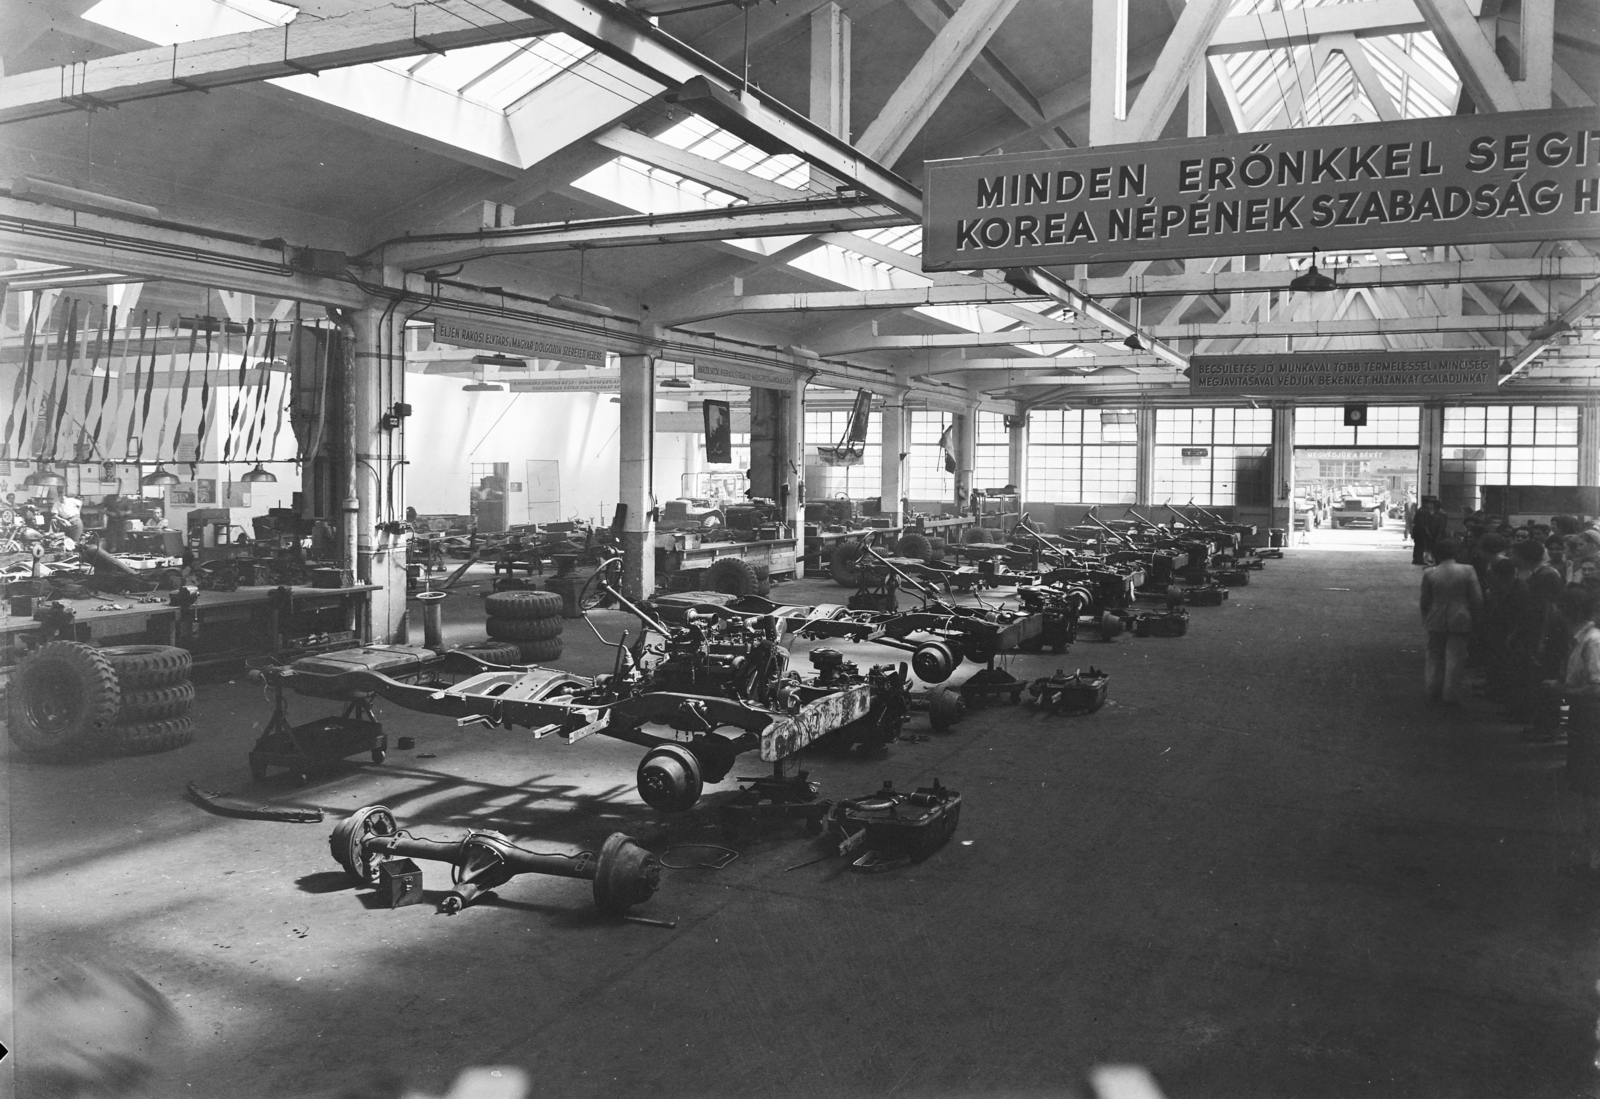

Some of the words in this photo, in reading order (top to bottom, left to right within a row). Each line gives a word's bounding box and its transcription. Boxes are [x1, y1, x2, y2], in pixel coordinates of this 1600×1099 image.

[977, 163, 1147, 209] MINDEN
[1179, 141, 1443, 194] ERŐNKKEL
[956, 211, 1098, 251] KOREA
[1108, 193, 1305, 241] NÉPÉNEK
[1310, 172, 1563, 228] SZABADSÁG
[440, 324, 460, 339] ÉLJEN
[461, 328, 484, 343] RÁKOSI
[512, 338, 533, 351] MAGYAR
[1199, 363, 1257, 374] BECSÜLETES
[1260, 361, 1275, 374] JÓ
[1279, 361, 1331, 373] MUNKÁVAL
[1334, 361, 1361, 373] TÖBB
[1365, 360, 1432, 373] TERMELÉSSEL
[1439, 358, 1489, 370] MINŐSÉG
[1278, 374, 1316, 386] VÉDJÜK
[1307, 451, 1351, 459] MEGVÉDJÜK
[1360, 451, 1383, 459] BÉKÉT
